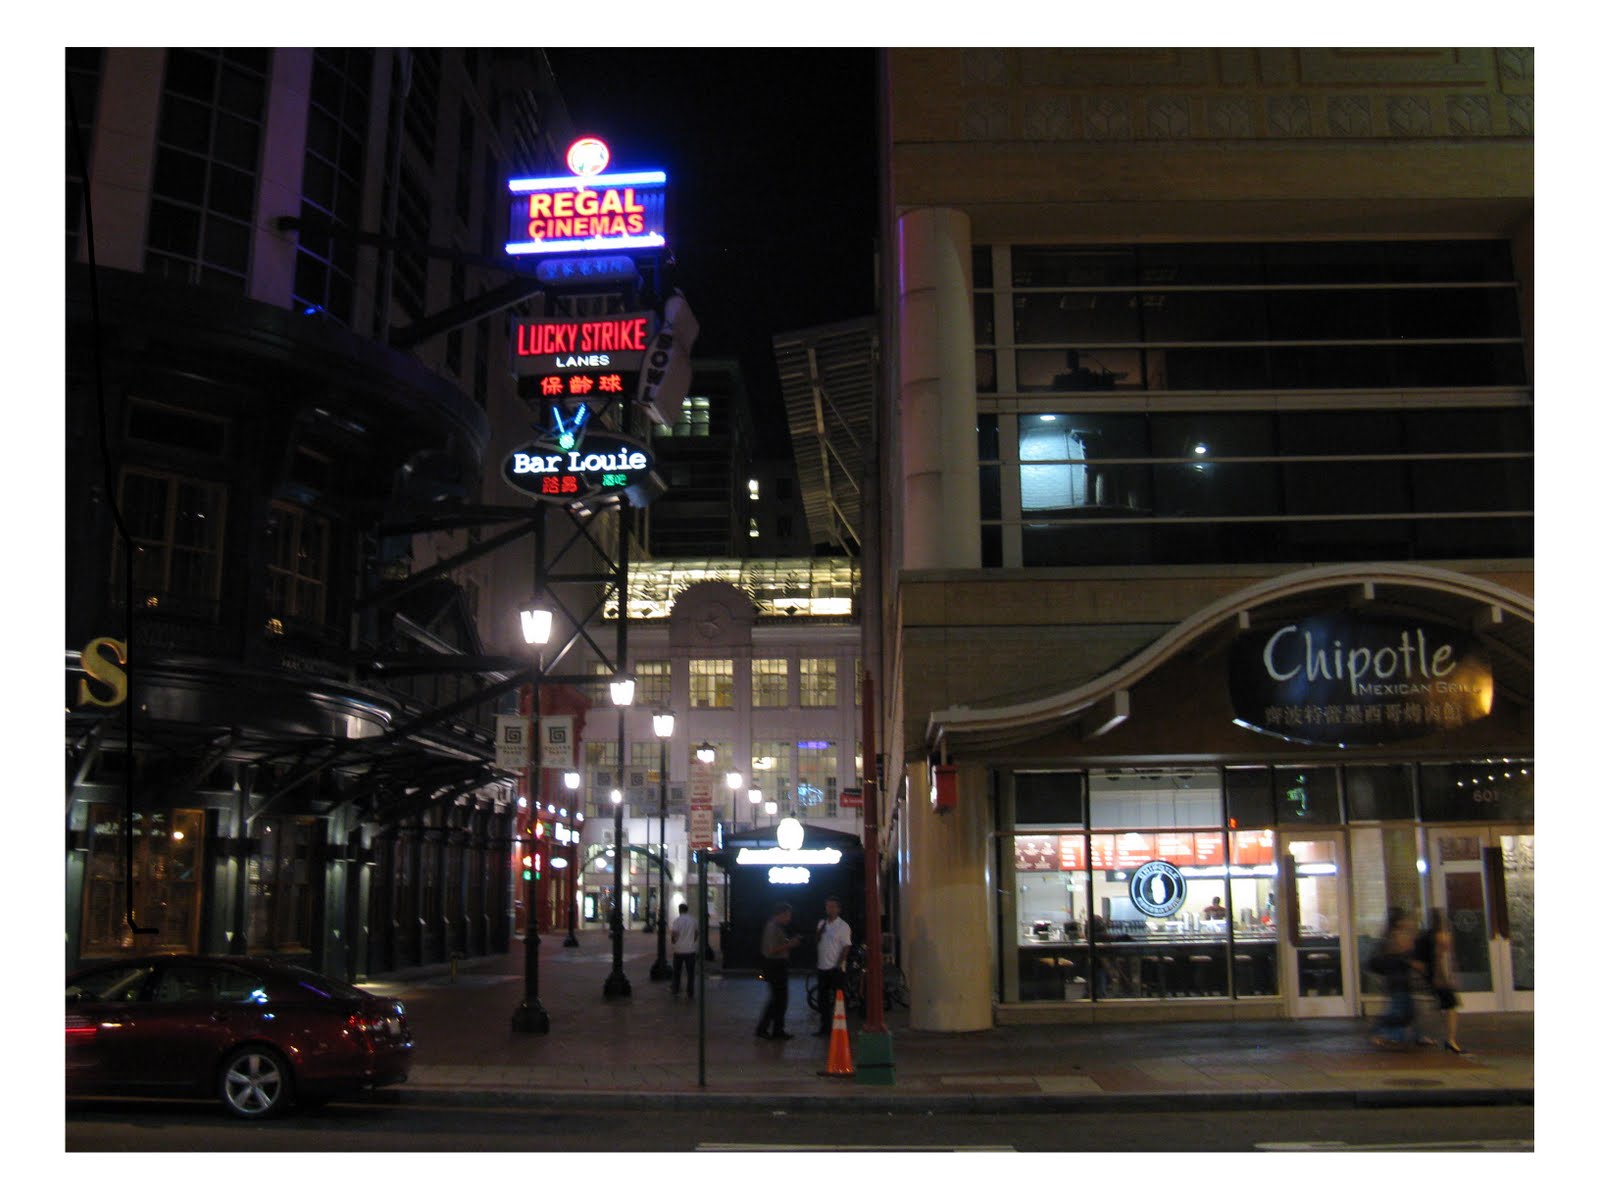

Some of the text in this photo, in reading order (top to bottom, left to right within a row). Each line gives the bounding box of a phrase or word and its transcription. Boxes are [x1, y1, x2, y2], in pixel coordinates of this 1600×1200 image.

[529, 188, 645, 219] REGAL
[528, 213, 645, 239] CINEMAS
[517, 318, 647, 355] LUCKY STRIKE
[556, 354, 610, 368] LANES
[513, 447, 647, 474] Bar Louie
[1262, 625, 1457, 695] Chipotle
